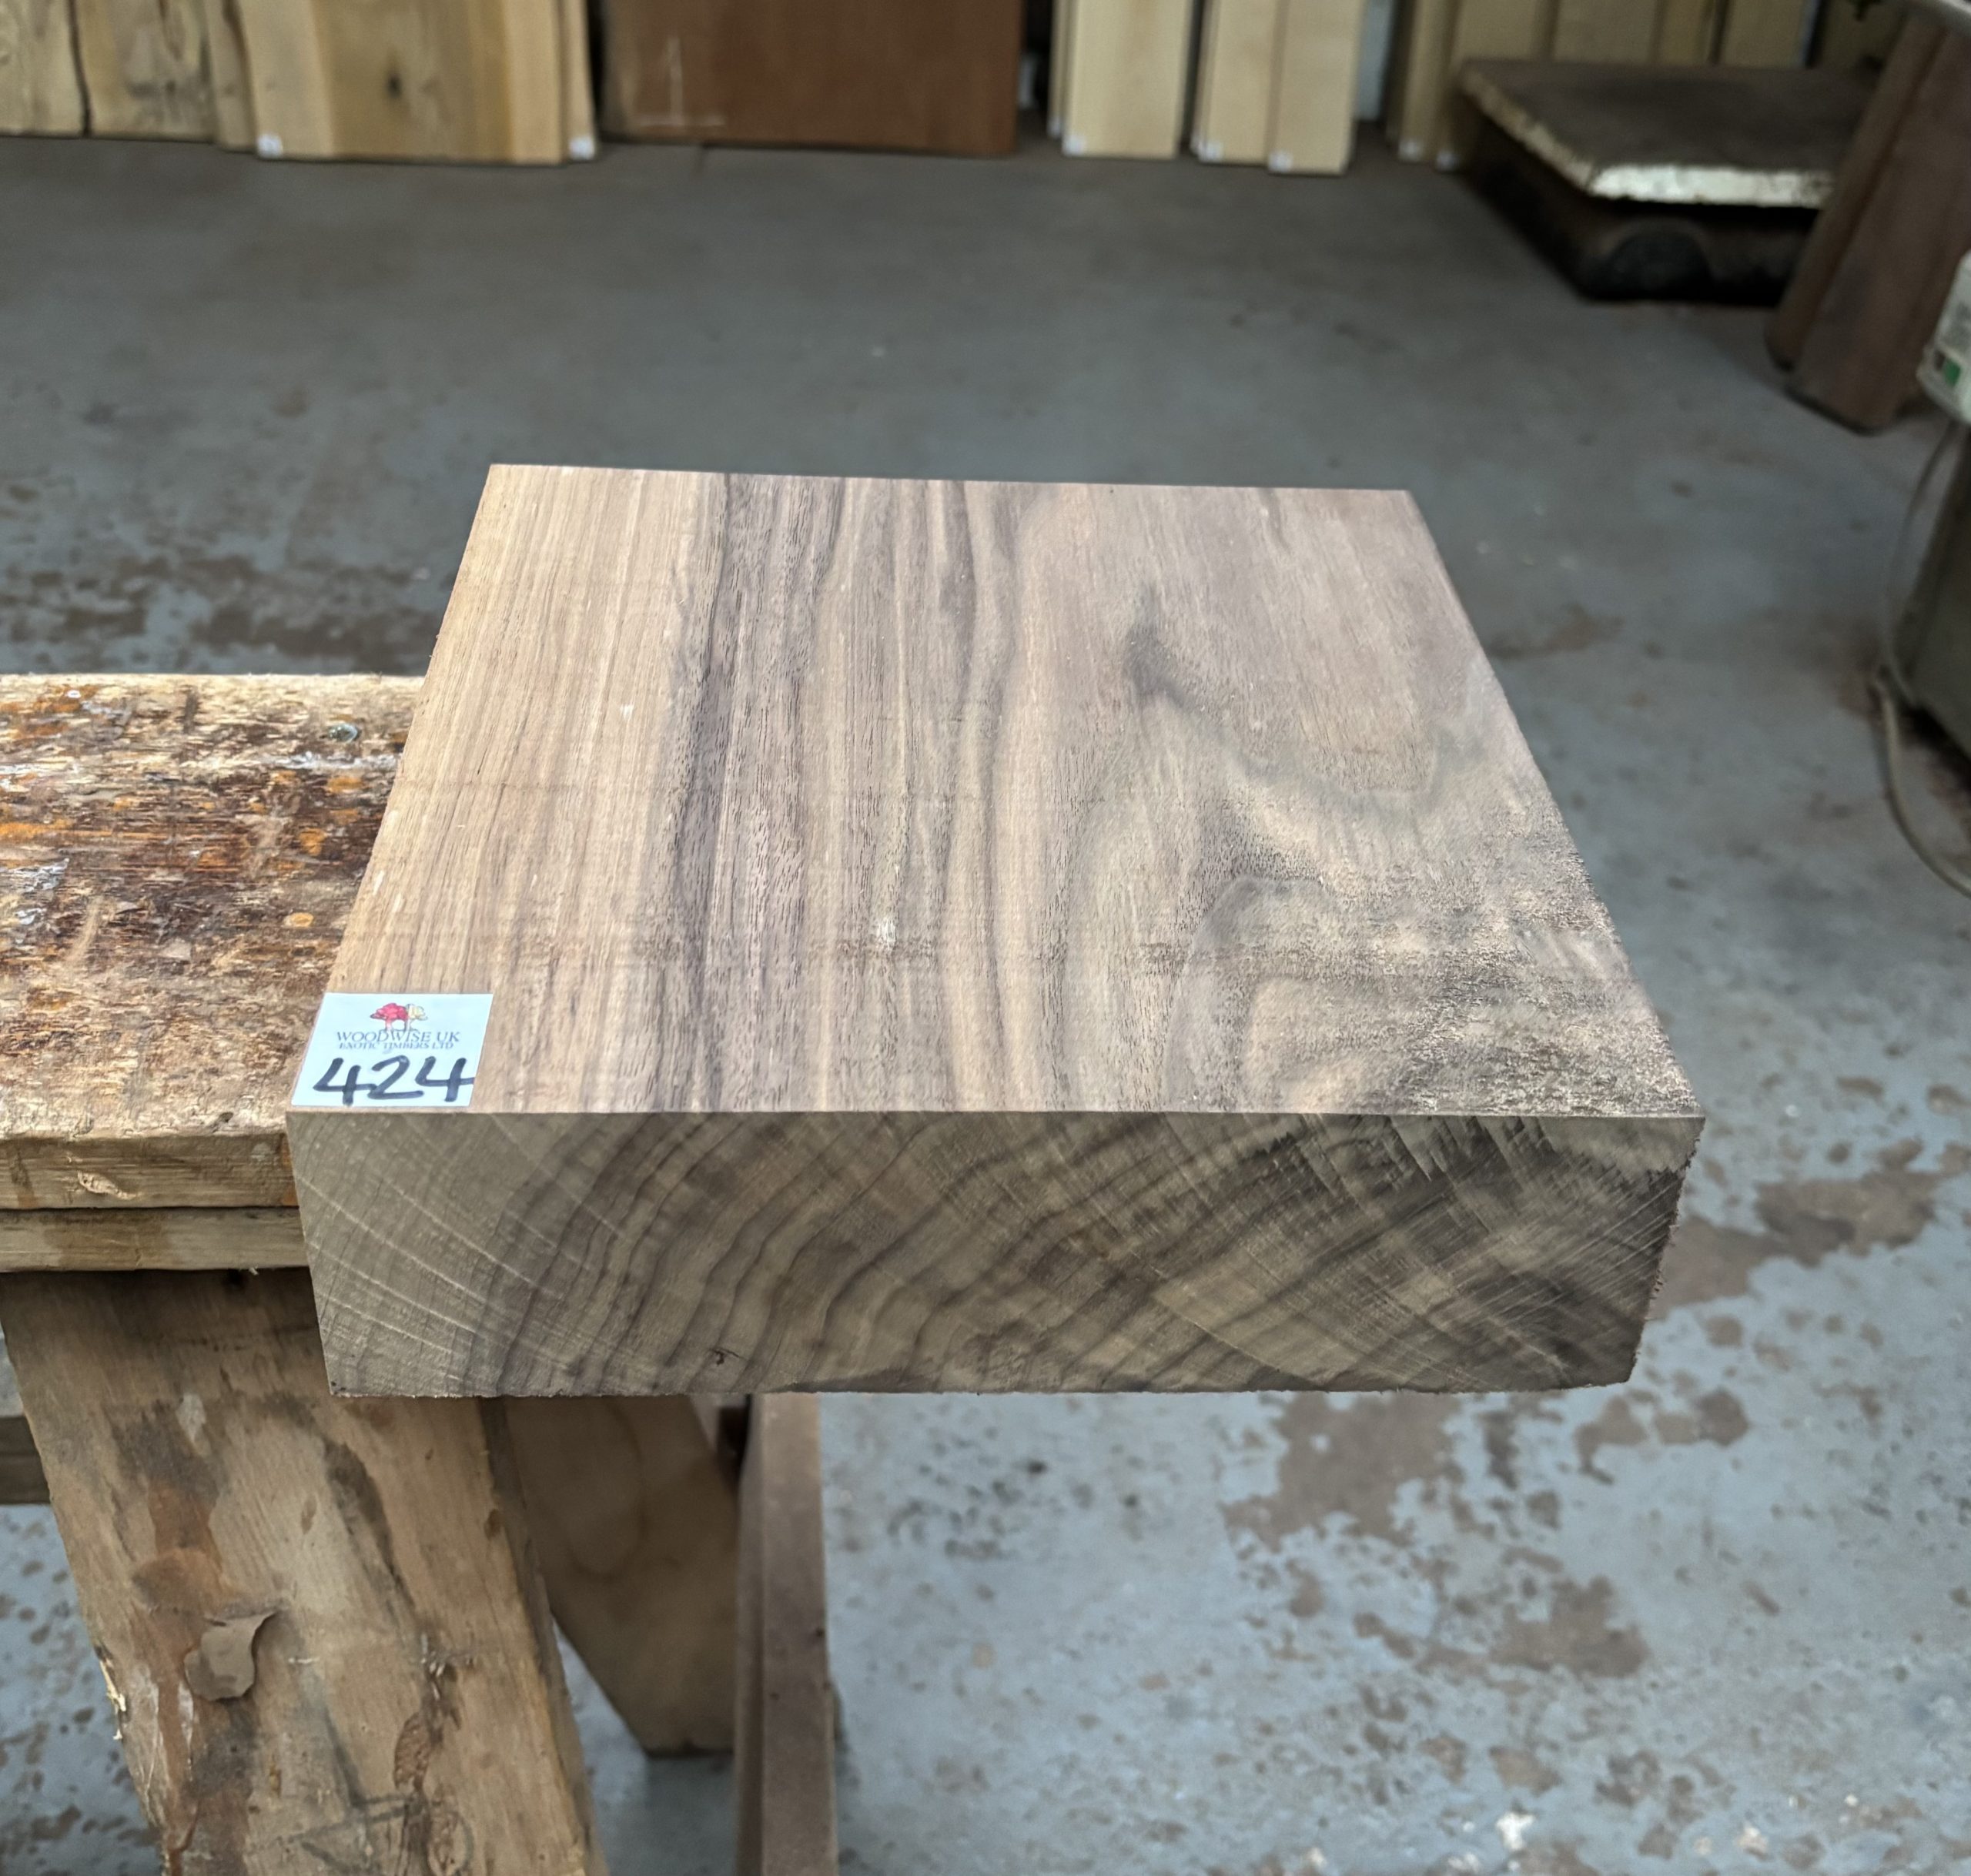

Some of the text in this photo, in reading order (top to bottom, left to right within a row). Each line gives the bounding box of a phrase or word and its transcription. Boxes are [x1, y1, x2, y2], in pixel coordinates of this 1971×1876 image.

[336, 1029, 460, 1042] WOODWISE UK
[339, 1042, 454, 1051] EXOTIC TIMBERS LTD
[313, 1055, 474, 1106] 424
